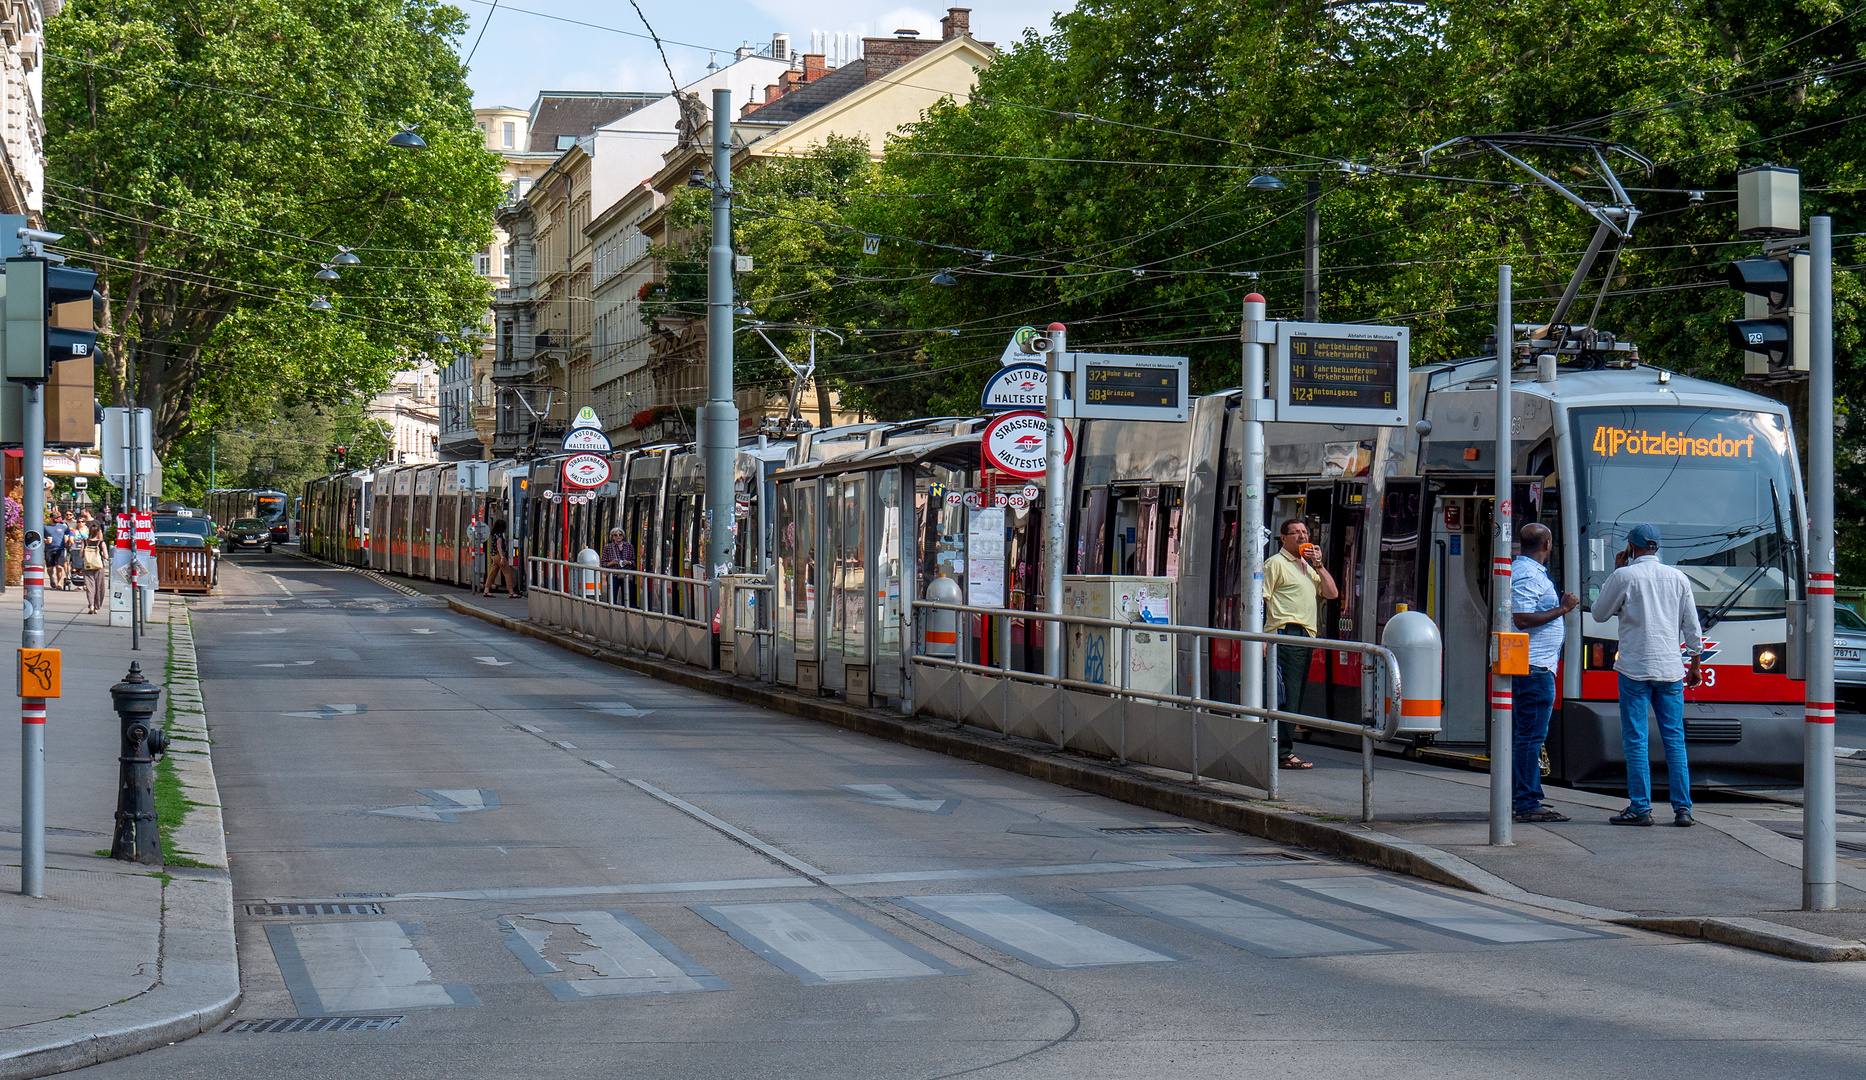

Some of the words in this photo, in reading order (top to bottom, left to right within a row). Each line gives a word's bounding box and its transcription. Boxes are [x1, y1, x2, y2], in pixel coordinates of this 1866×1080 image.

[865, 237, 879, 252] W
[1749, 333, 1763, 343] 29
[74, 344, 87, 354] 13
[1292, 342, 1307, 355] 40
[1313, 342, 1378, 352] Fahrtbehinderung
[1313, 350, 1370, 359] Verkehrsunfall
[1088, 370, 1101, 381] 37
[1292, 365, 1305, 378] 41
[1313, 365, 1378, 375] Fahrtbehinderung
[1313, 372, 1370, 381] Verkehrsunfall
[1003, 370, 1047, 386] AUTOBU
[994, 393, 1047, 404] HALTESTE
[1088, 389, 1101, 400] 38
[1106, 389, 1135, 397] Grinzing
[1292, 387, 1306, 401] 42
[1313, 388, 1358, 397] Antonigasse
[995, 419, 1047, 440] STRASSENB
[1511, 416, 1522, 435] 63
[574, 430, 602, 440] AUTOBUS
[1613, 428, 1754, 458] Pötzleinsdorf
[568, 456, 607, 470] STRASSENBAHN
[997, 449, 1047, 469] HALTESTE
[570, 473, 605, 484] HALTESTELLE
[932, 487, 942, 497] N
[1024, 488, 1037, 497] 37
[947, 495, 961, 504] 42
[965, 495, 978, 503] 41
[1009, 497, 1024, 506] 38
[117, 529, 151, 541] Zeiung
[1834, 650, 1858, 658] 7871A
